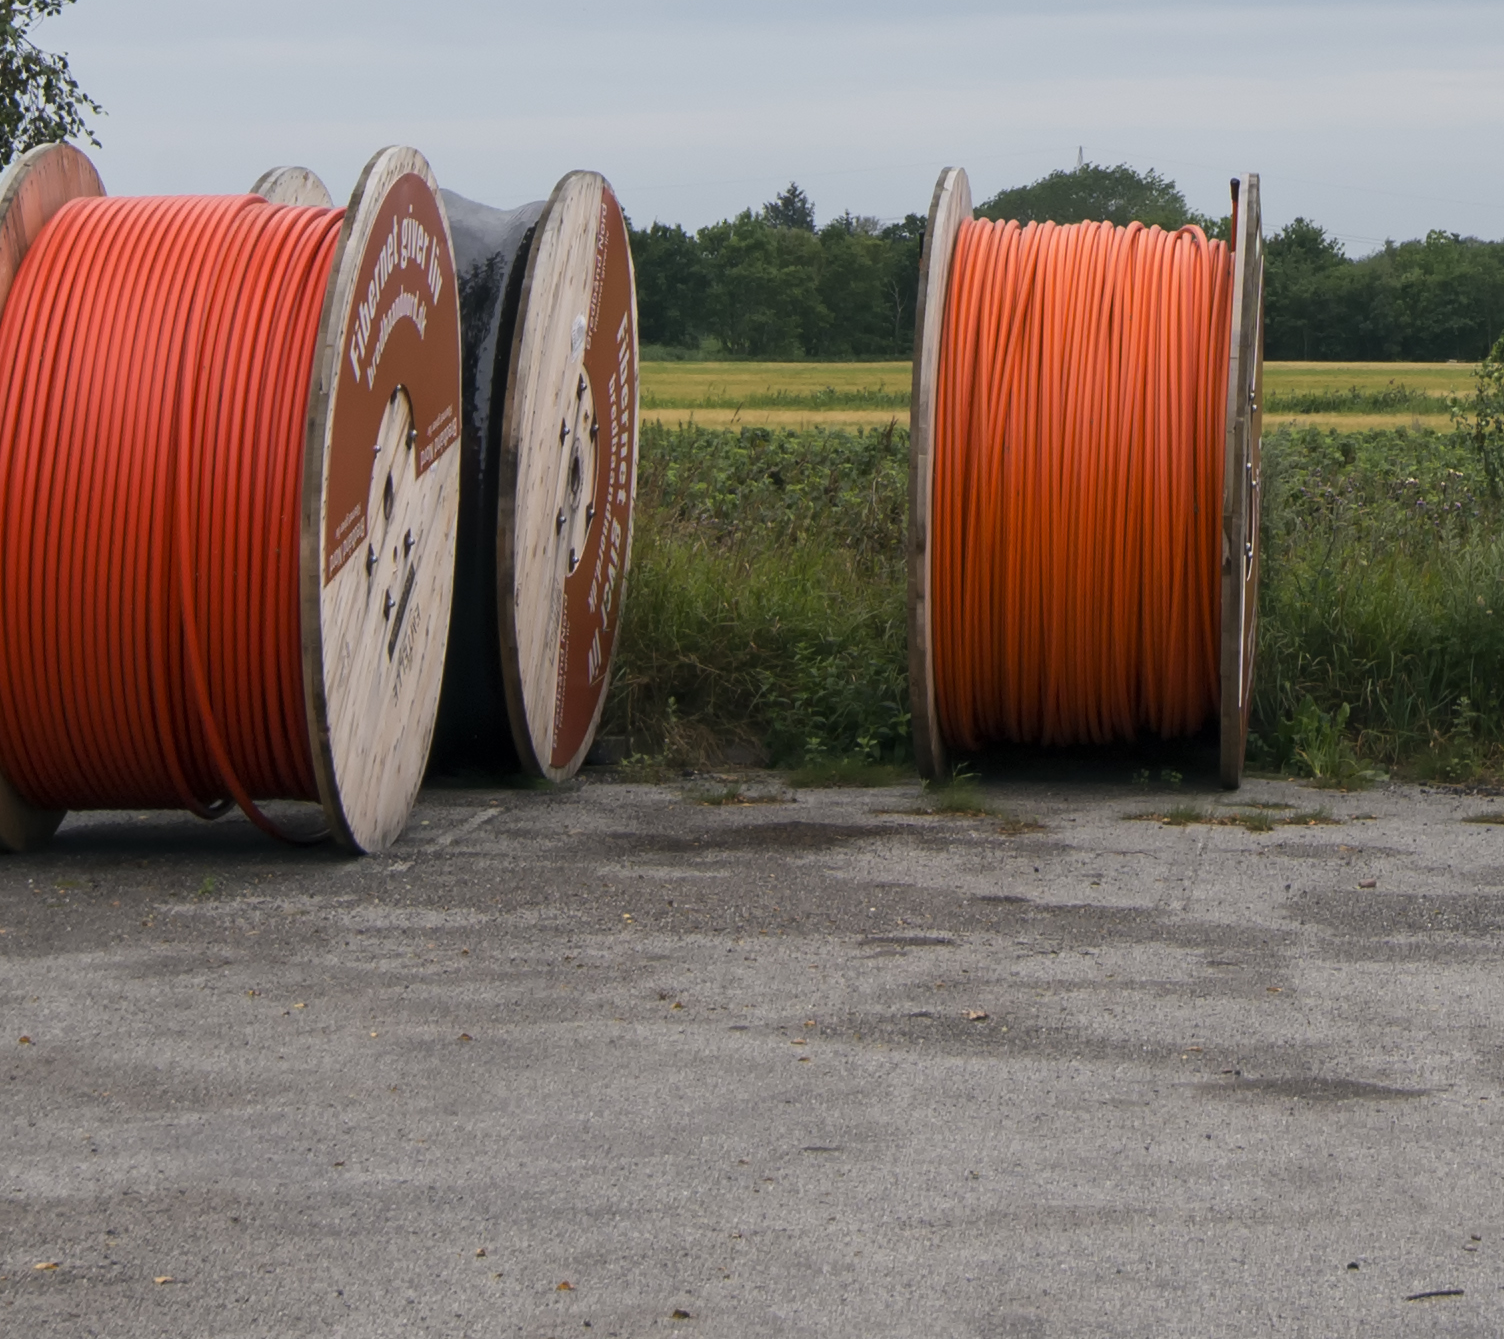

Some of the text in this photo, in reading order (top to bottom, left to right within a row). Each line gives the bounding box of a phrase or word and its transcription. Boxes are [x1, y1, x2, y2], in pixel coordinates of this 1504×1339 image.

[349, 204, 443, 383] Fibernet giver liv
[597, 202, 608, 250] Nord
[617, 310, 630, 506] Fibernet
